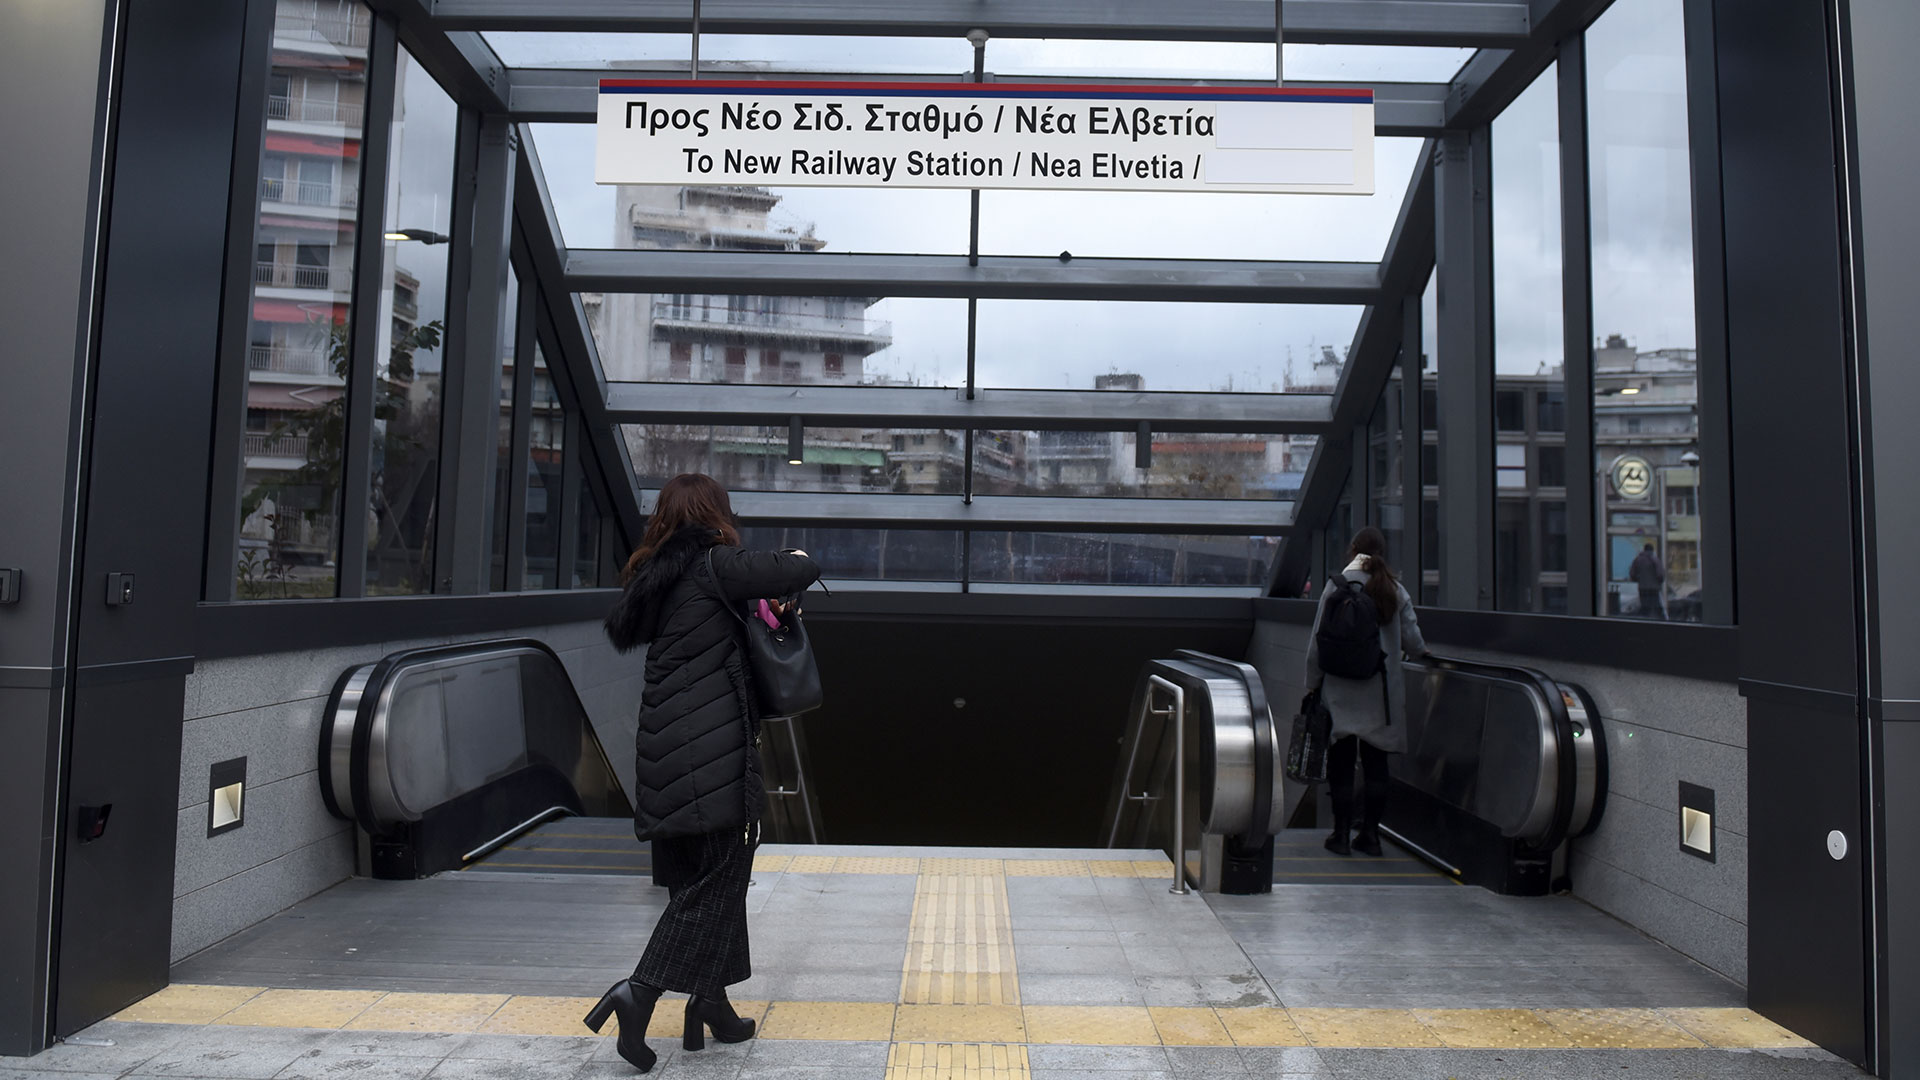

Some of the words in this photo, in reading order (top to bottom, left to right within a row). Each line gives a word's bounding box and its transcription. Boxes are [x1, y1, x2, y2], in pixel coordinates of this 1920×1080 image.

[625, 101, 710, 138] Προς
[721, 101, 782, 131] Νέο
[793, 102, 852, 132] Σιδ.
[864, 103, 984, 140] Σταθμό
[993, 105, 1005, 134] /
[1015, 105, 1077, 135] Νέα
[1089, 106, 1215, 143] Ελβετία
[682, 147, 714, 174] To
[724, 148, 782, 175] New
[791, 149, 897, 183] Railway
[906, 150, 1003, 177] Station
[1012, 151, 1022, 177] /
[1031, 151, 1081, 178] Nea
[1092, 152, 1184, 180] Elvetia
[1192, 154, 1202, 180] /
